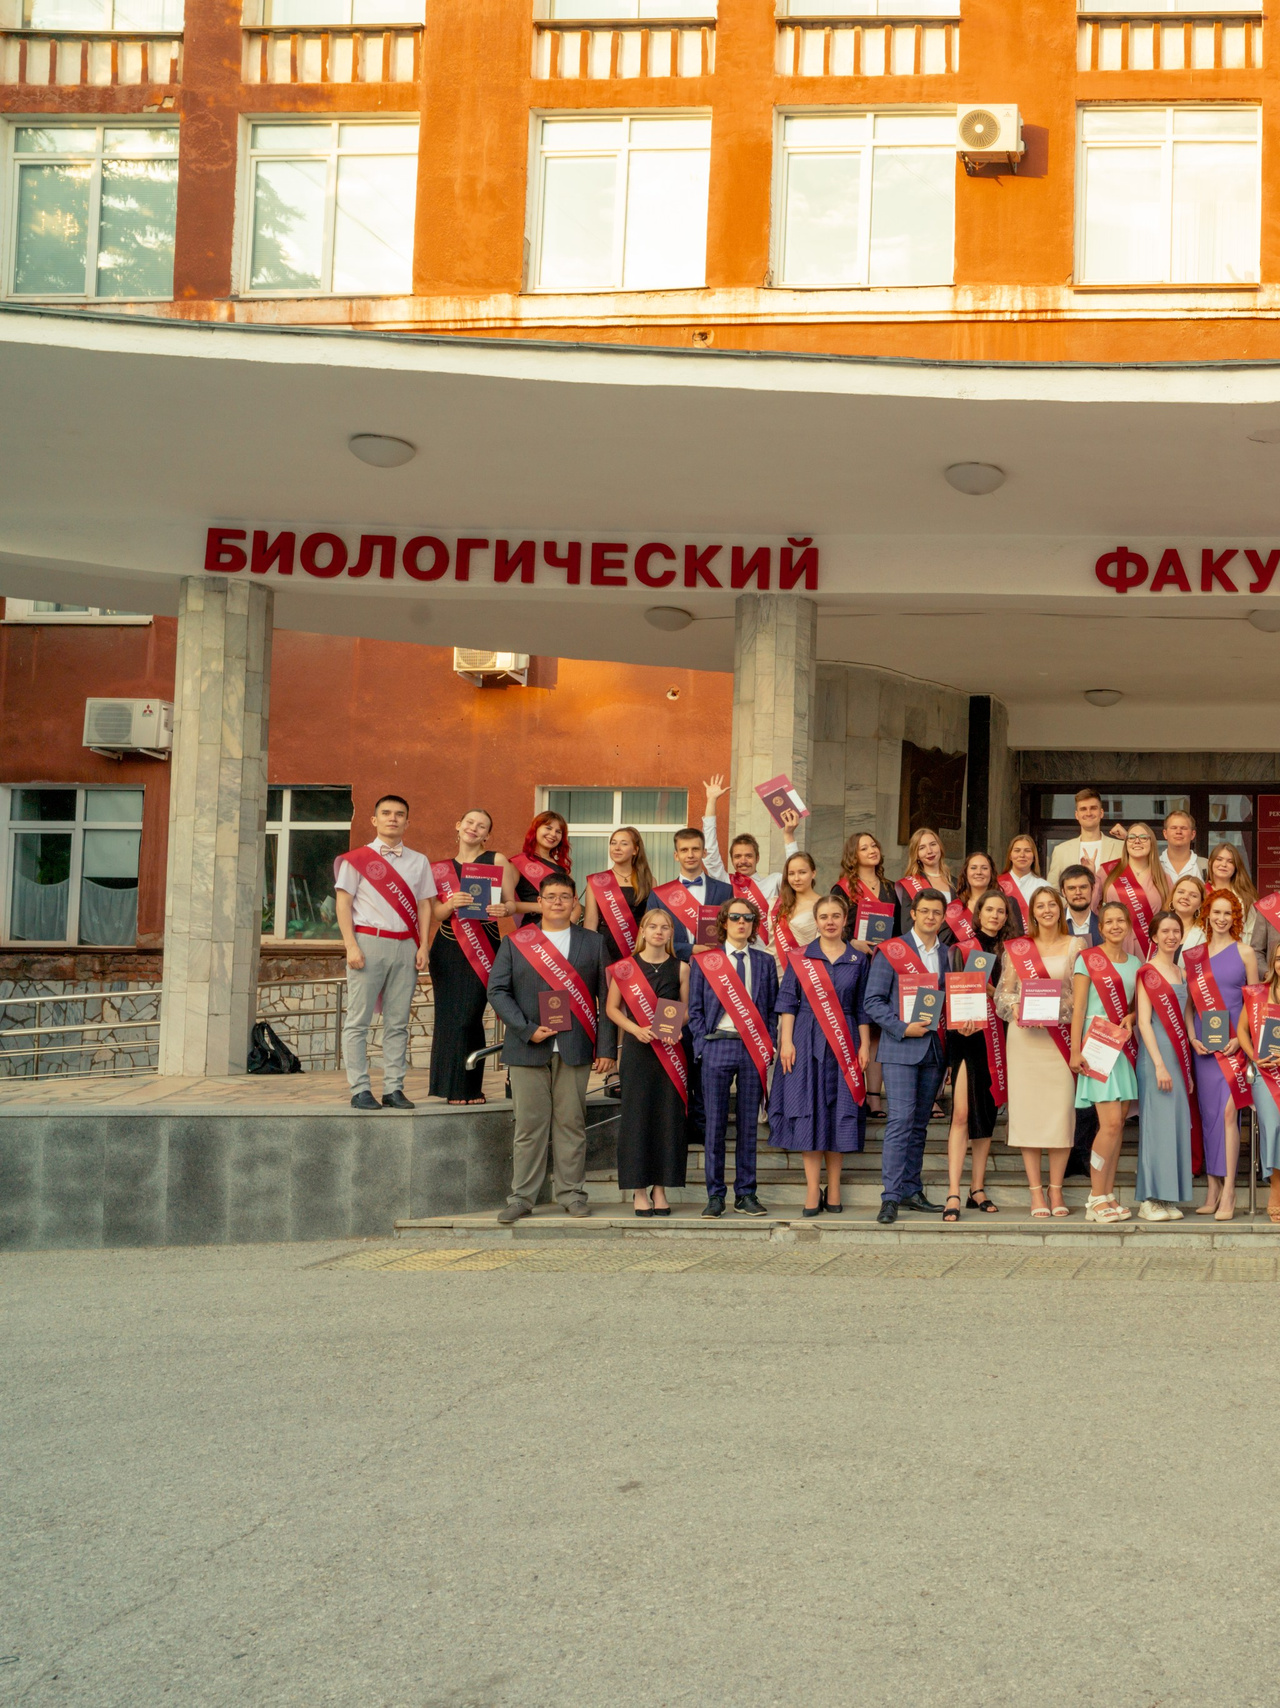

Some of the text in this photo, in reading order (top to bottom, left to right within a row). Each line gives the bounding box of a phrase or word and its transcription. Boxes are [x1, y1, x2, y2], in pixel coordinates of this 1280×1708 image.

[204, 528, 820, 591] БИОЛОГИЧЕСКИЙ
[603, 890, 629, 931] ЛУЧШИЙ
[461, 921, 492, 974] ВЫПУСКН
[531, 943, 567, 987] ЛУЧШИЙ
[1024, 959, 1039, 980] ЛУЧ
[629, 983, 655, 1024] ЛУЧШИ
[718, 974, 771, 1070] ЛУЧШИЙ ВЫПУСКН
[802, 958, 860, 1087] ЛУЧШИЙ ВЫПУСКНИК 2024
[1159, 993, 1184, 1037] ЛУЧШИЙ
[1195, 962, 1248, 1094] ЛУЧШИЙ 2024
[997, 1069, 1005, 1091] 2024
